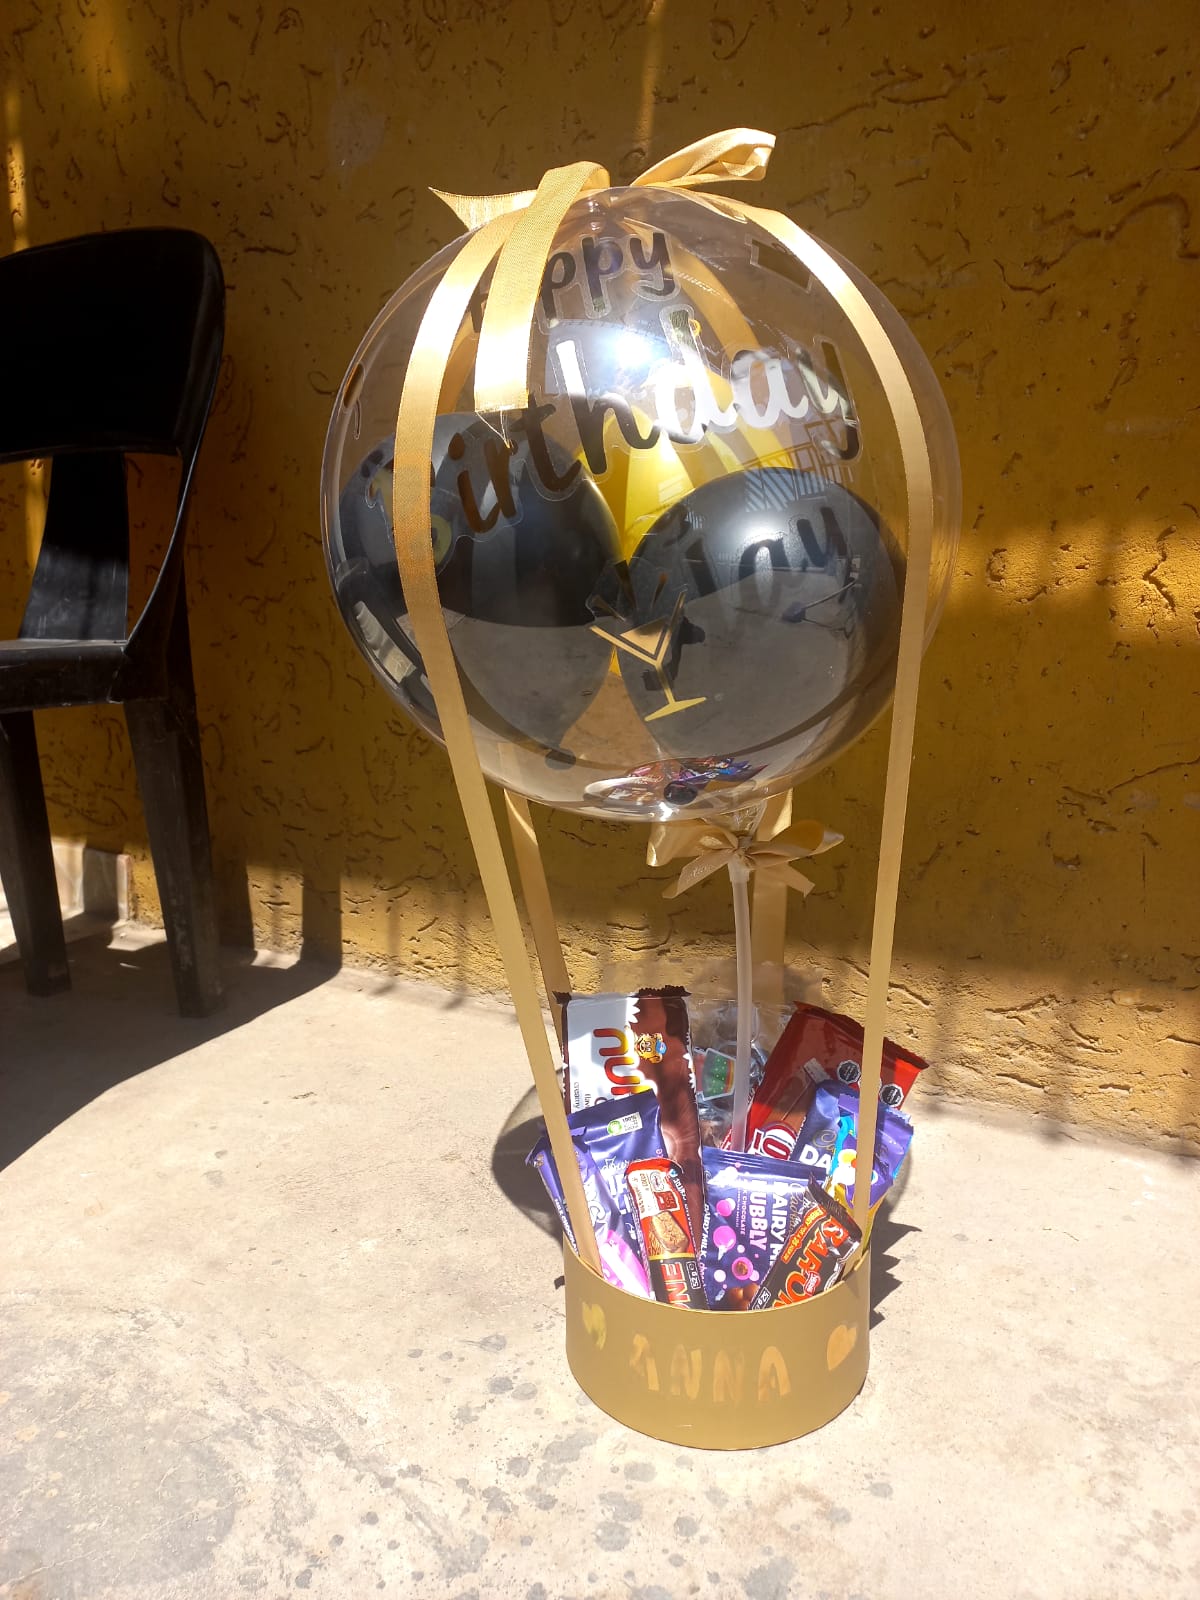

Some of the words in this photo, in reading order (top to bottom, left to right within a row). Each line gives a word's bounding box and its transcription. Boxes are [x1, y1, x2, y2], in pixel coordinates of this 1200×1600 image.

[540, 231, 680, 328] ppy
[450, 308, 862, 535] irthday
[701, 1237, 710, 1258] MILK
[797, 1215, 849, 1275] BAR
[661, 1261, 692, 1308] NE
[628, 1332, 792, 1403] ANNA
